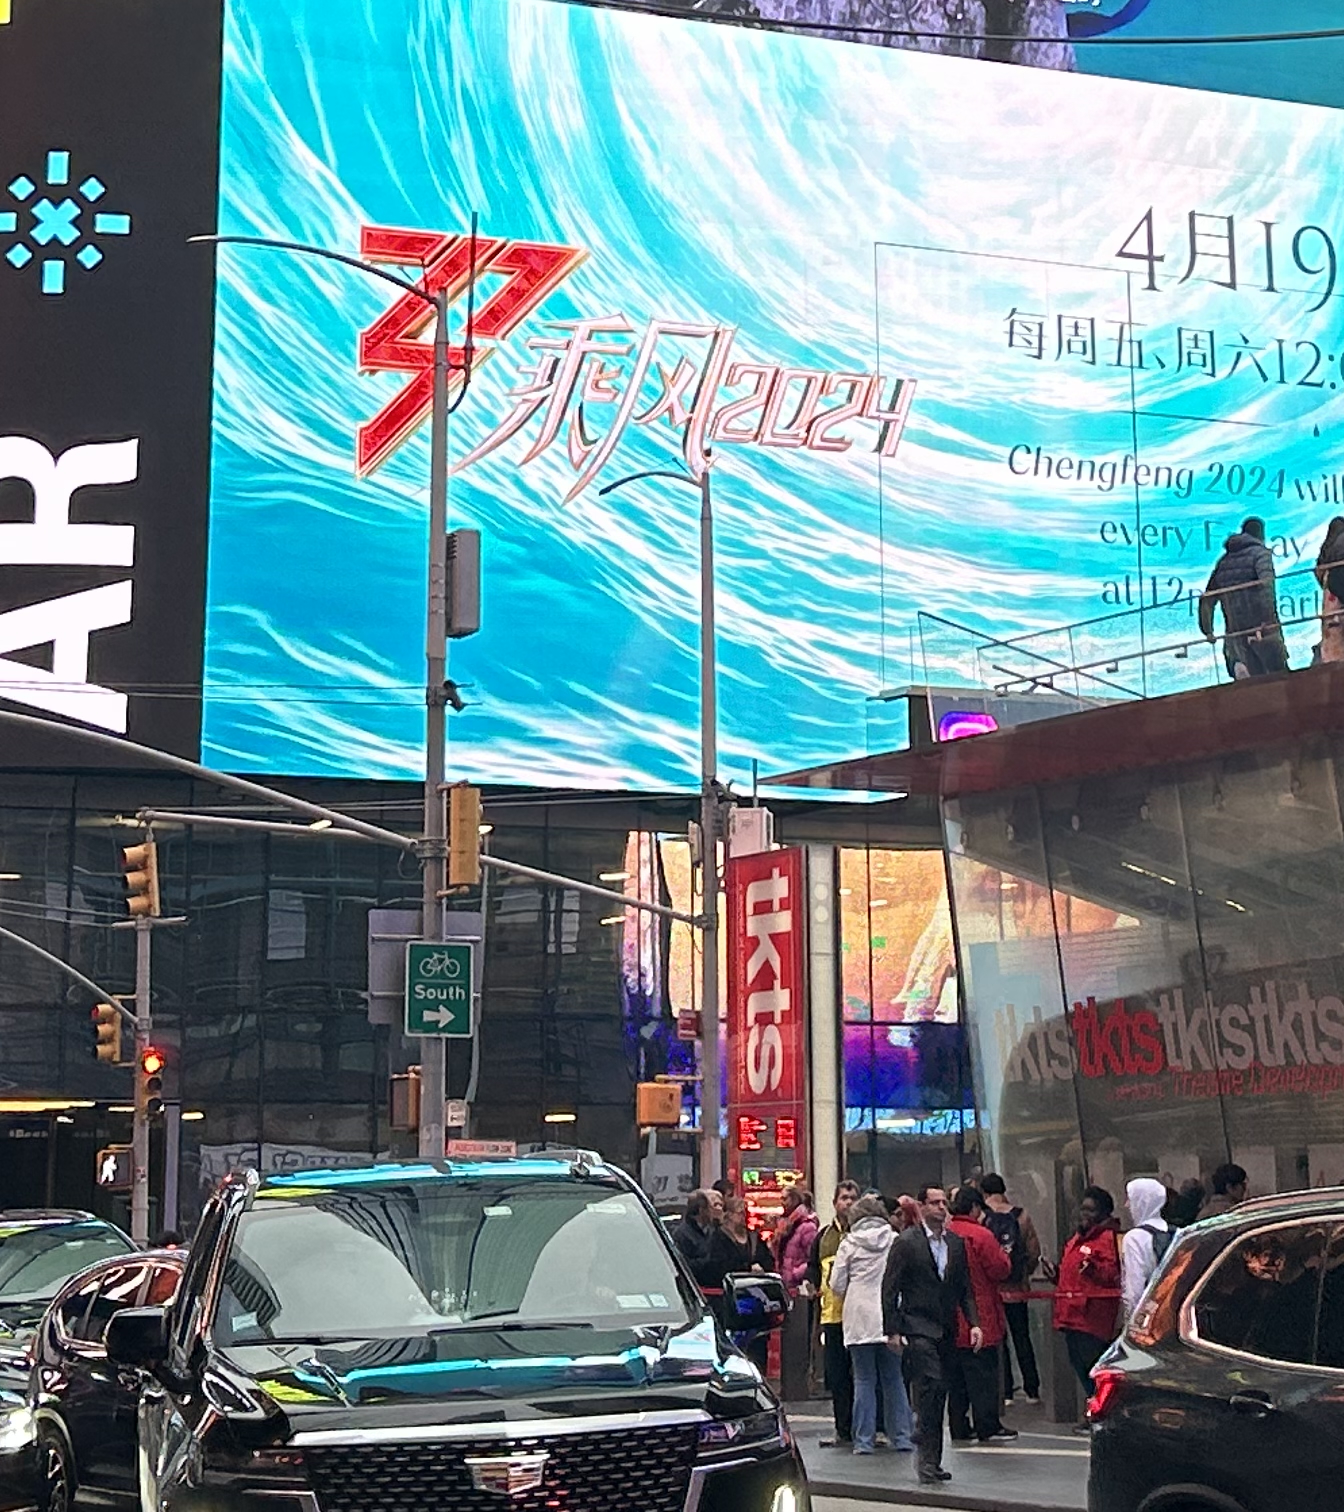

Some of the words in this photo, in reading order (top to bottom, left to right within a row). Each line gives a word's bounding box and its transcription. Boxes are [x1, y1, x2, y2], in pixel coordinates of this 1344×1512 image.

[1007, 442, 1196, 500] Chengfeng
[1206, 462, 1287, 500] 2024
[1099, 520, 1194, 557] every
[1203, 520, 1308, 565] Fay
[1102, 575, 1134, 607] at
[1150, 575, 1202, 618] 12p
[413, 984, 466, 1002] South
[746, 867, 794, 1096] tkts
[1072, 996, 1166, 1078] tkts
